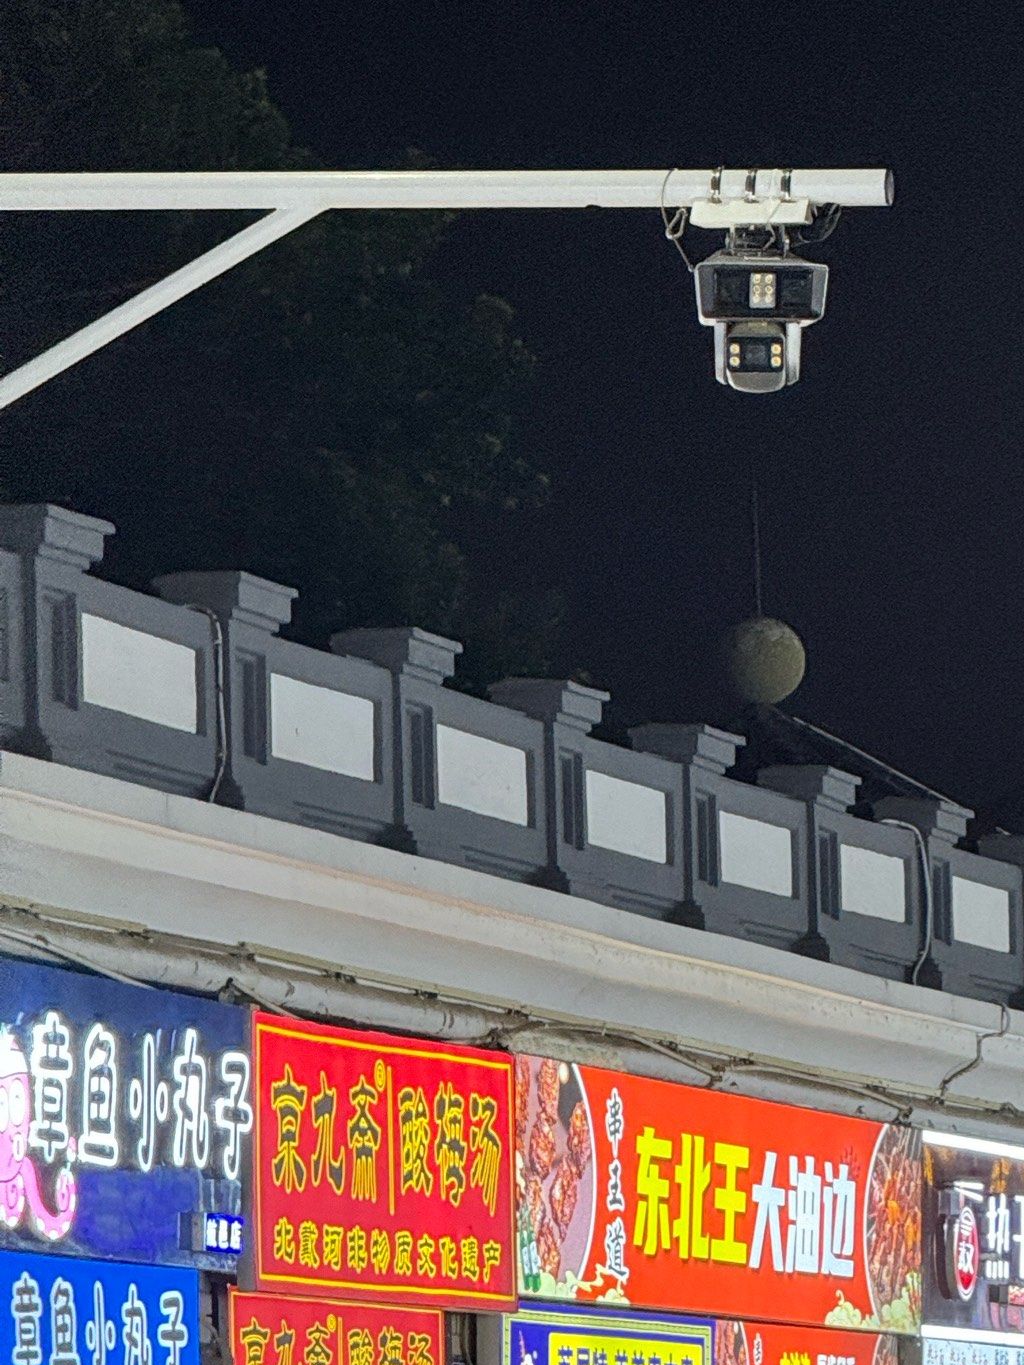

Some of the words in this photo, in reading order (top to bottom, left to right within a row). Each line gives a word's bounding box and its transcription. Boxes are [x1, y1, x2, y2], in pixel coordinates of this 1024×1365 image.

[29, 1011, 254, 1180] 章鱼小丸子
[398, 1081, 502, 1217] 酸梅汤
[273, 1216, 502, 1284] 北戴河非物质文化遗产
[605, 1087, 630, 1281] 串王道
[633, 1126, 857, 1279] 东北王大油边
